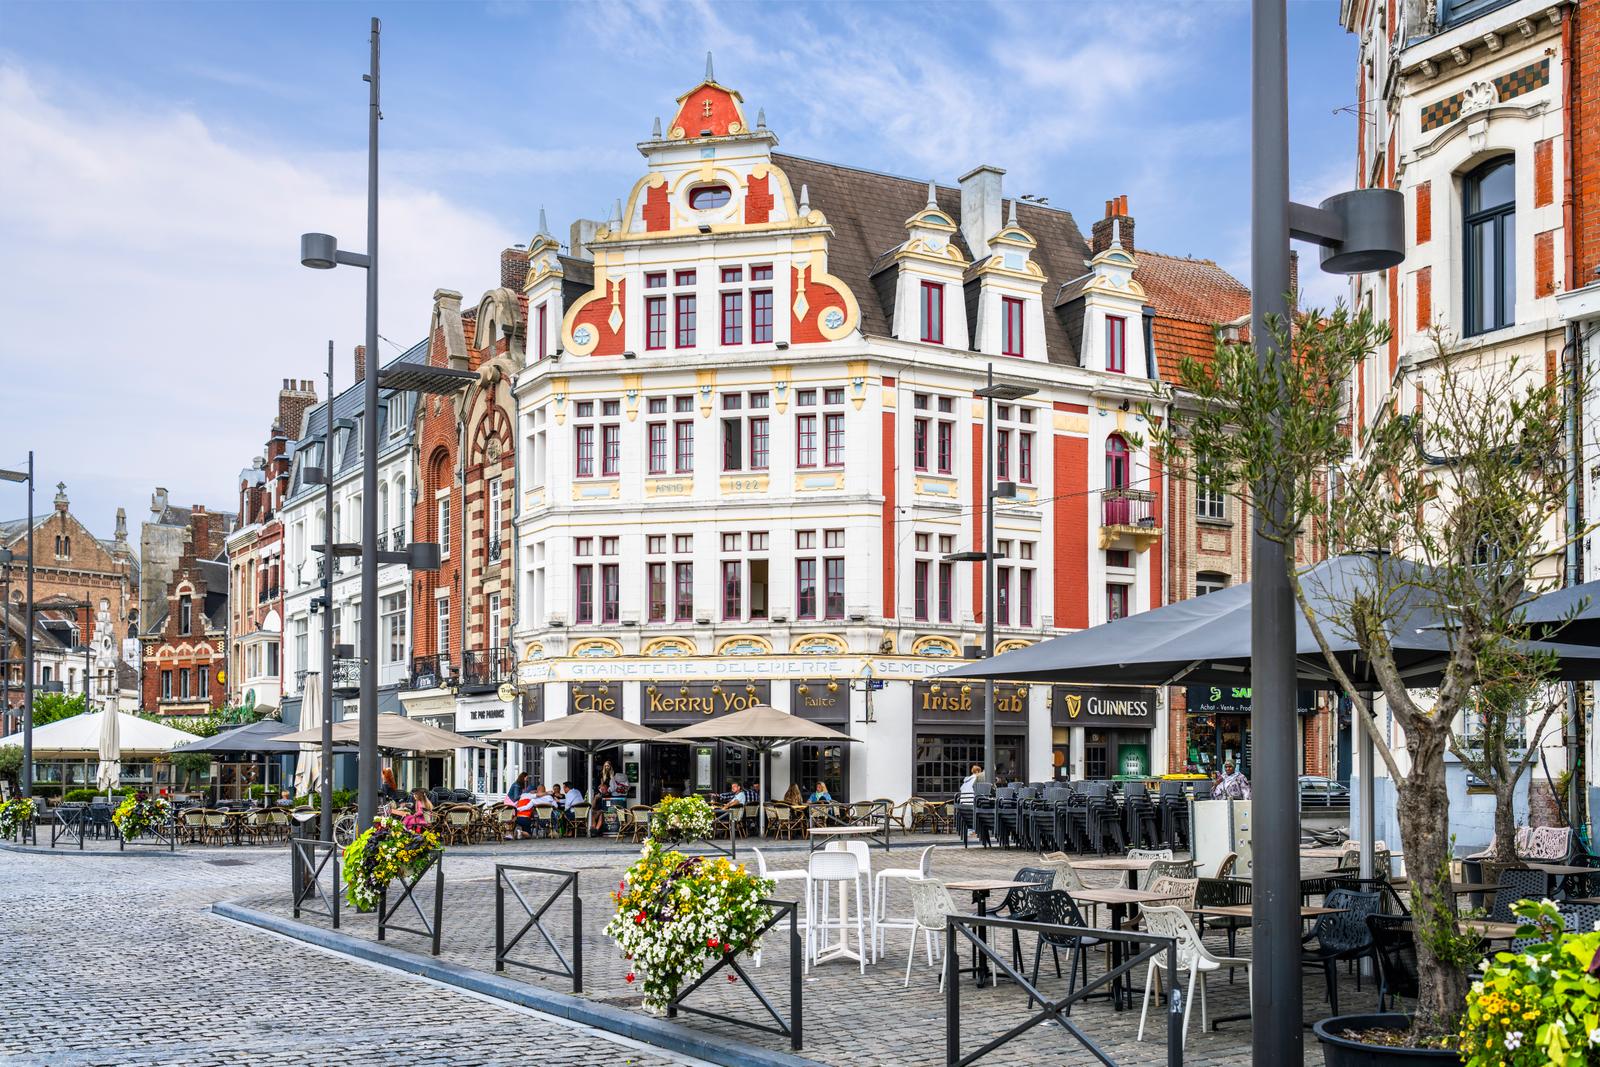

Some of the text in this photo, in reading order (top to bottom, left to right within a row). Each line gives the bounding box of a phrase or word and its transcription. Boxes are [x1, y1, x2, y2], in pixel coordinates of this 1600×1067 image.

[730, 480, 759, 489] 1922
[571, 662, 842, 675] GRAINETERIE DELEPIERRE
[574, 693, 616, 711] The
[922, 691, 1023, 712] Irish ub
[1087, 697, 1148, 716] GUINNESS
